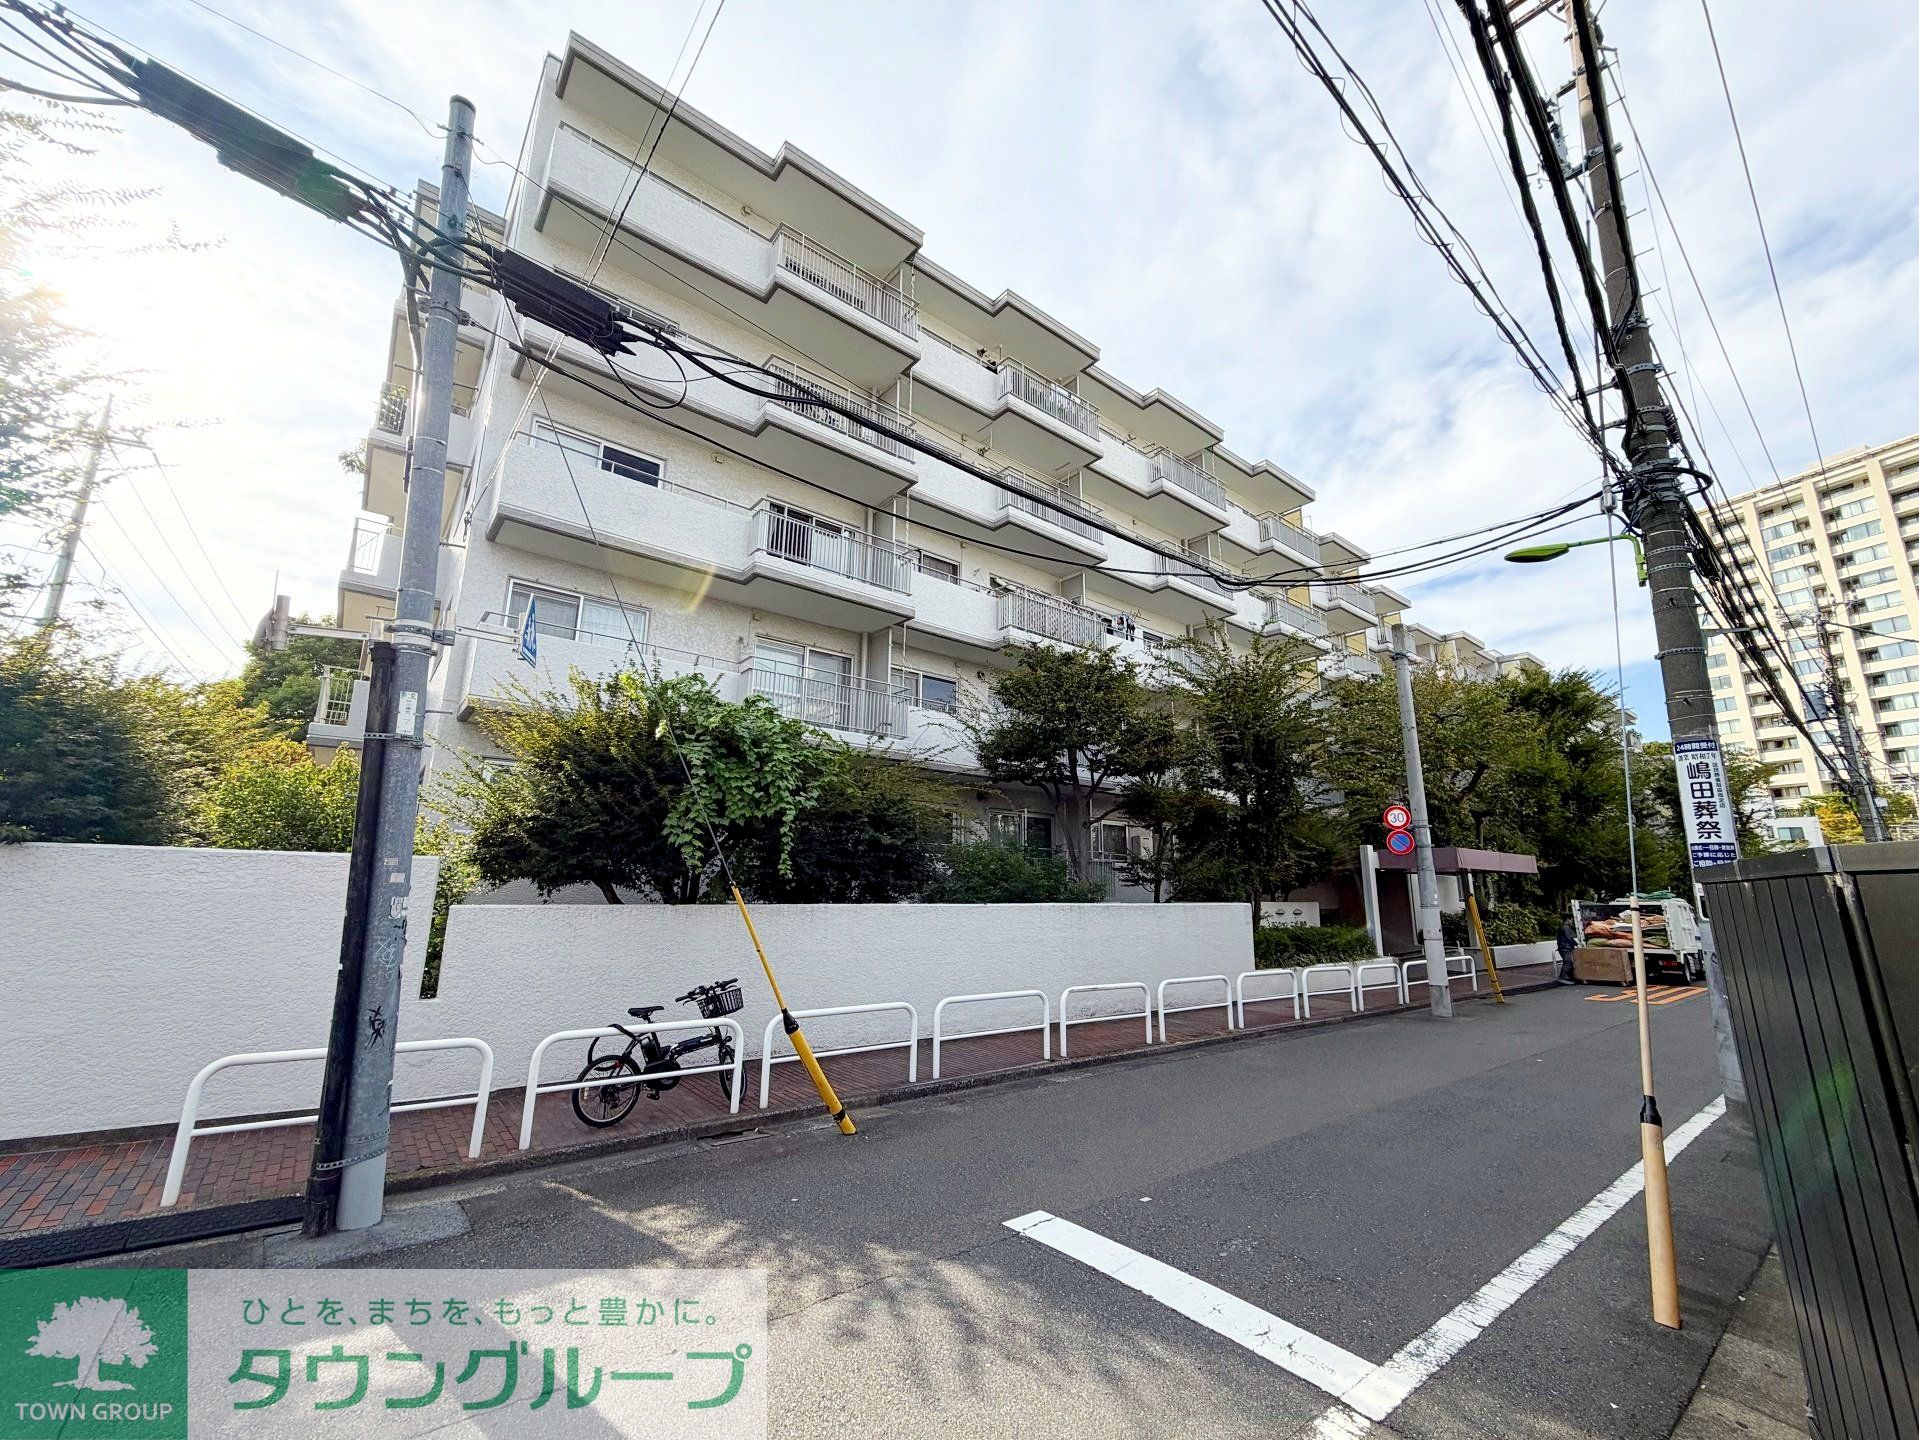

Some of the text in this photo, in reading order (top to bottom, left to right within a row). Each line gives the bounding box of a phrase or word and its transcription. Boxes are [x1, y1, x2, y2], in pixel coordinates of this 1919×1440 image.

[1676, 742, 1716, 752] 24時間受付
[1691, 753, 1716, 761] 昭和7年
[1686, 761, 1722, 840] 嶋田葬祭
[1390, 812, 1404, 824] 30
